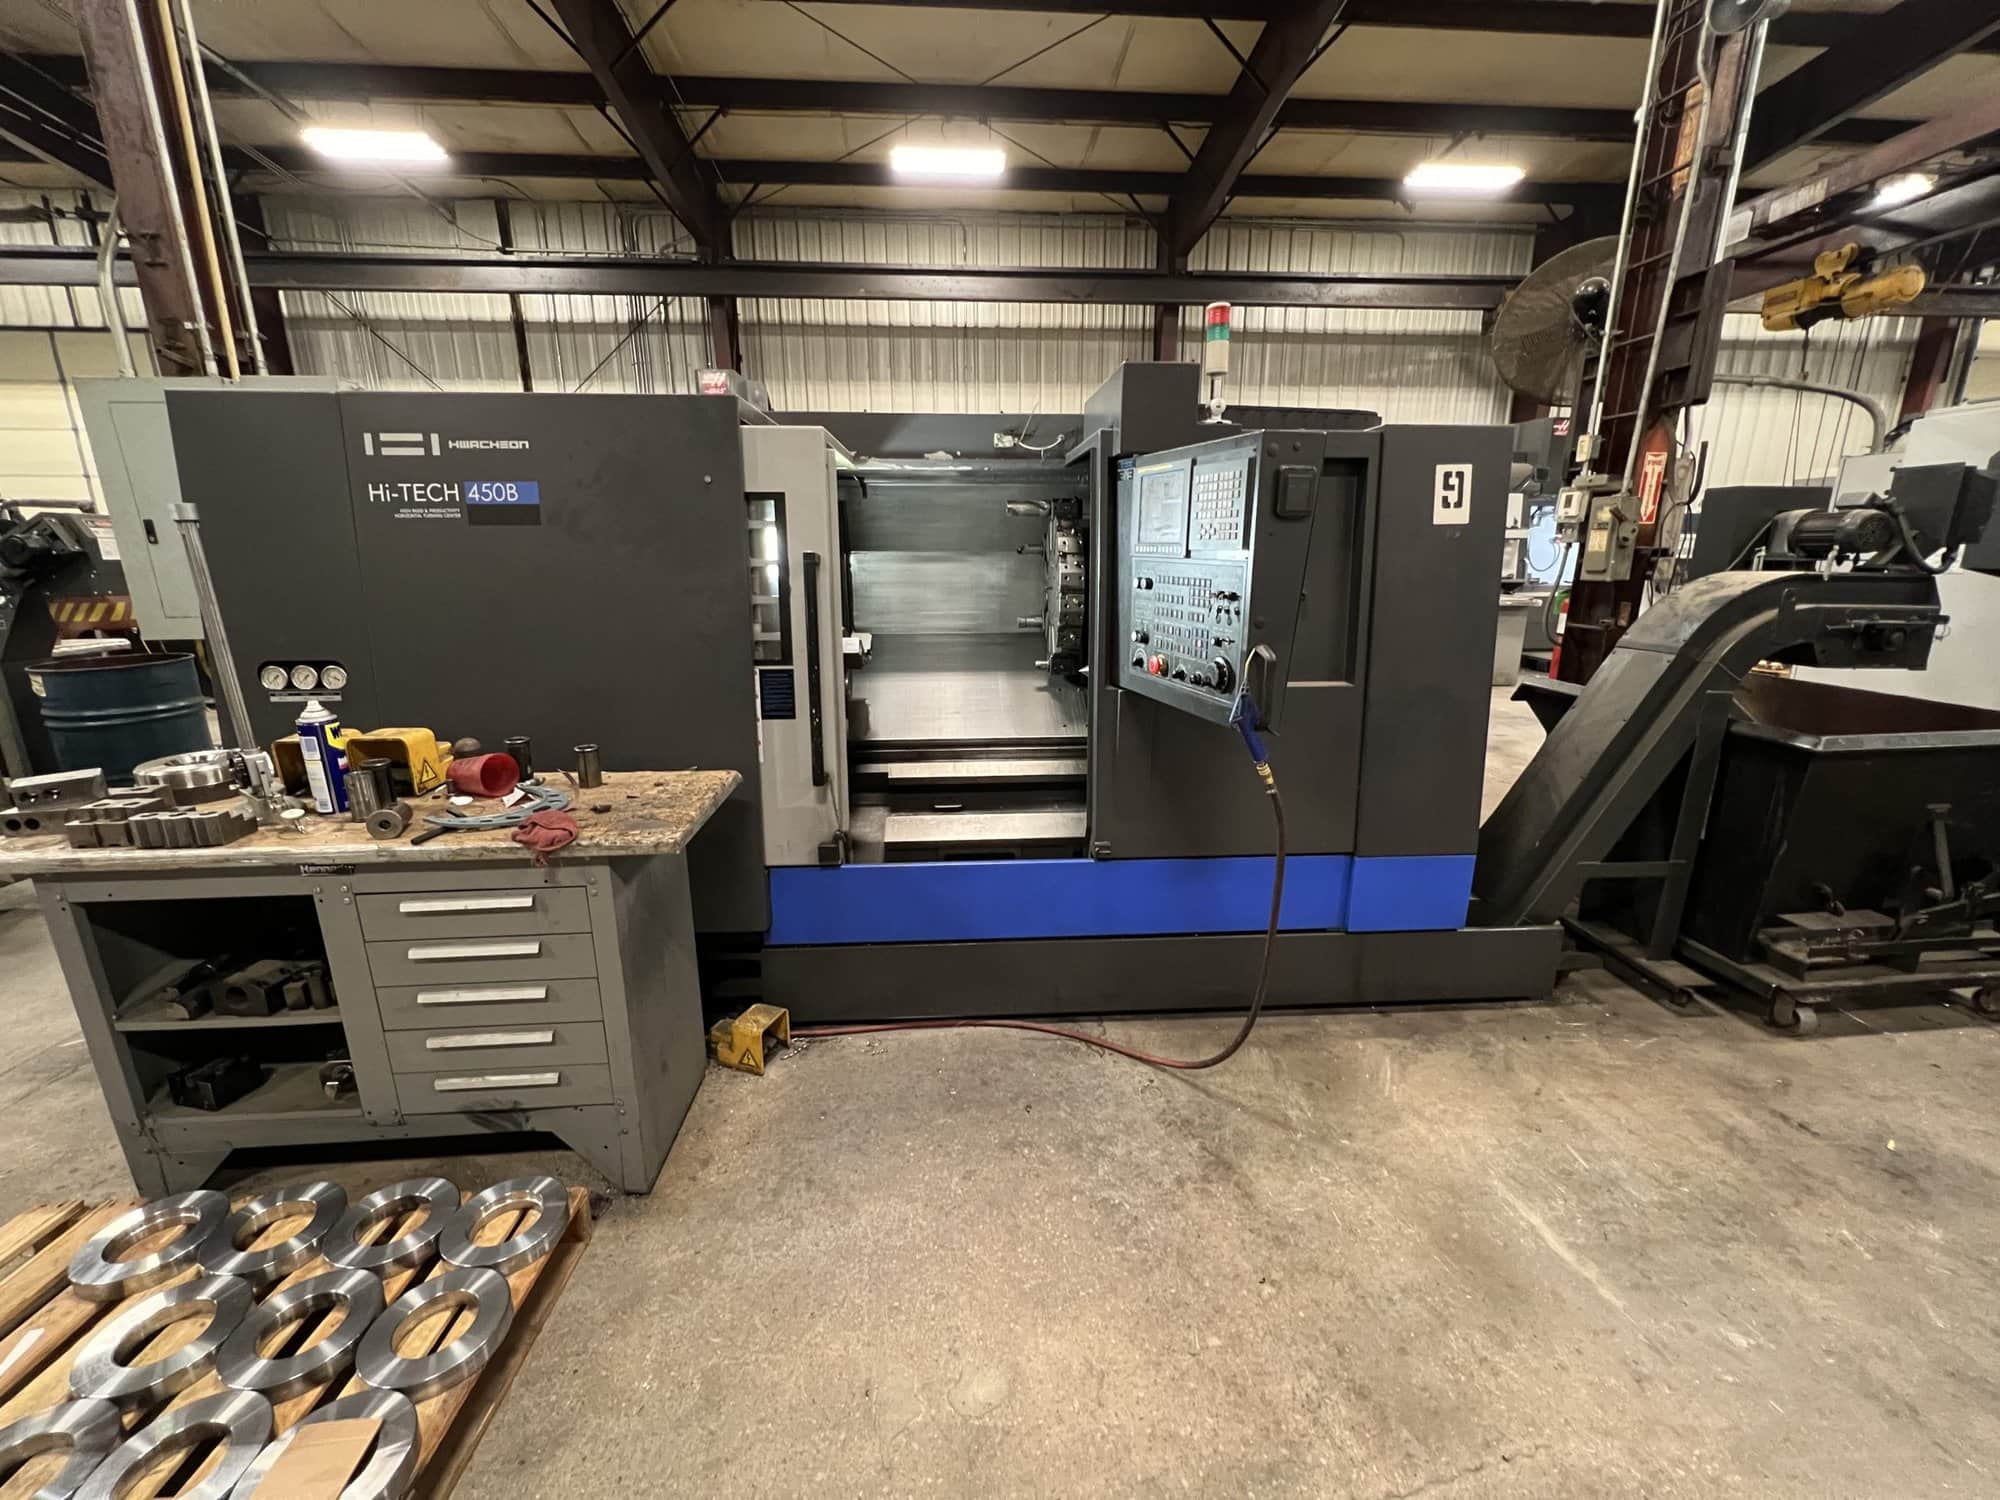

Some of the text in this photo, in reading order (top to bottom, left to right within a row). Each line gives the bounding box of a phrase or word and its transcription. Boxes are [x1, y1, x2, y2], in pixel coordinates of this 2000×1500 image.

[448, 440, 529, 449] HWACHEON
[368, 482, 519, 502] Hi-TECH 450B
